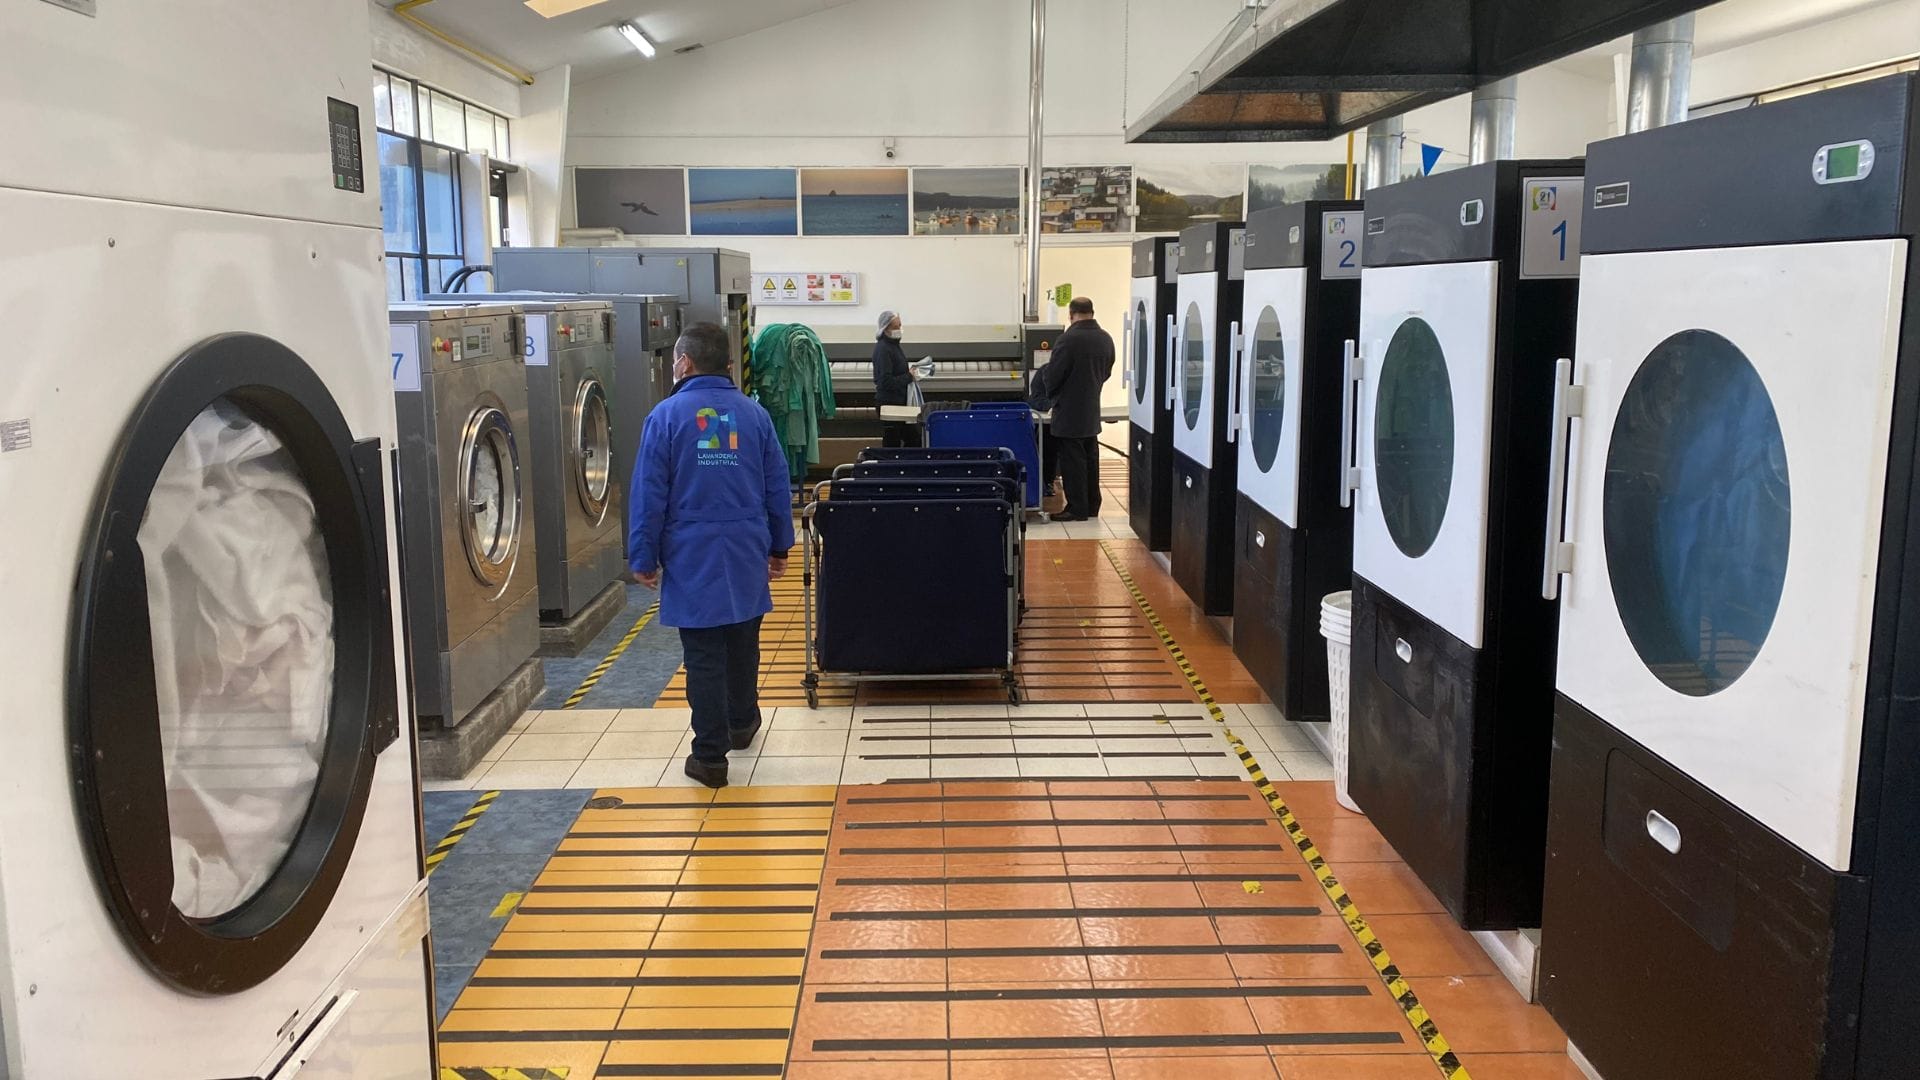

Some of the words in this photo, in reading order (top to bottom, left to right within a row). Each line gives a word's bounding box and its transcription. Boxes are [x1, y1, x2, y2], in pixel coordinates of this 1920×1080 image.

[1339, 240, 1356, 268] 2
[1552, 219, 1567, 261] 1
[525, 336, 536, 357] 8
[391, 353, 404, 380] 7
[696, 407, 738, 450] 21
